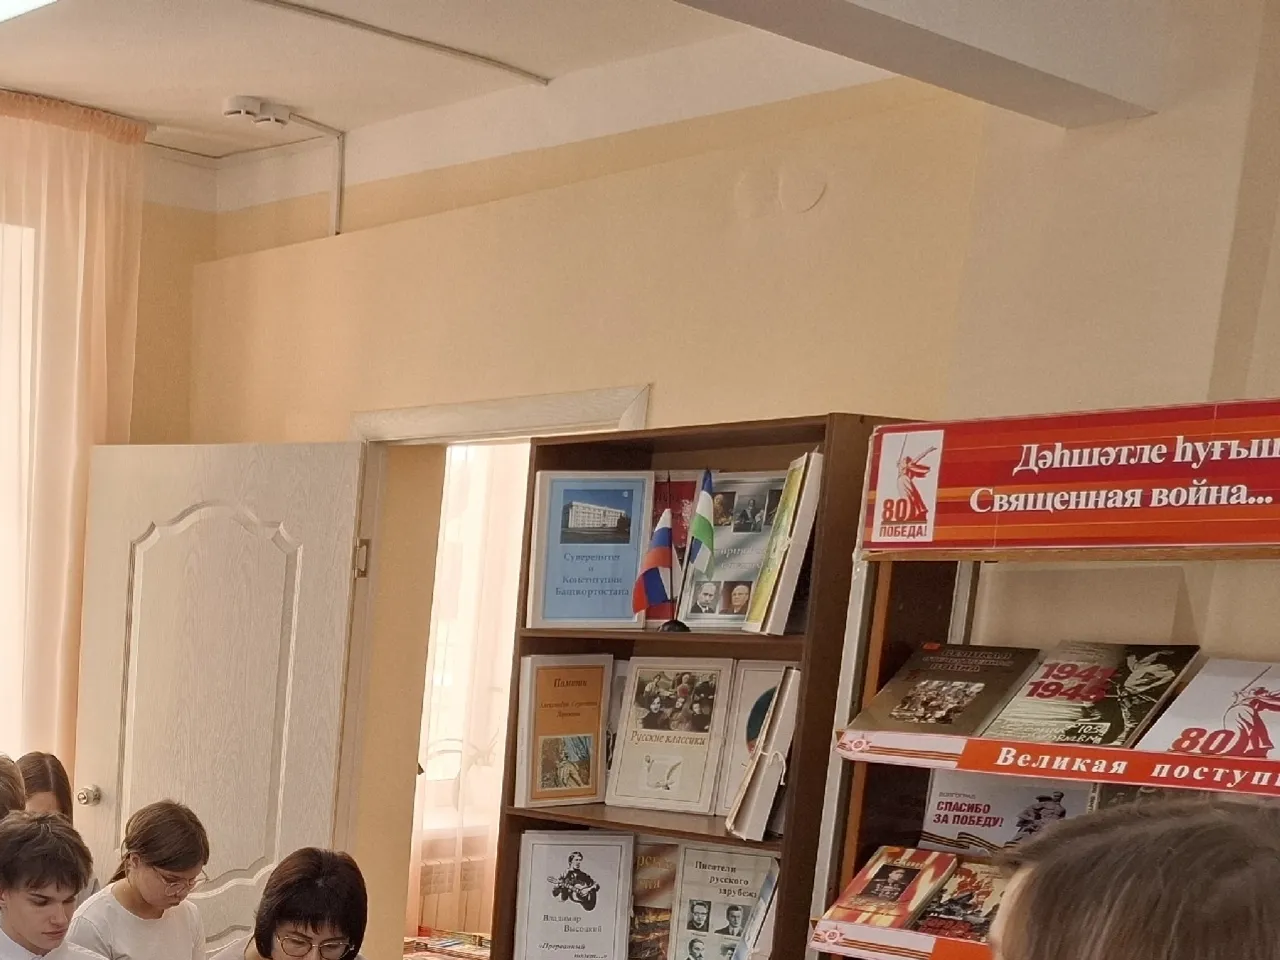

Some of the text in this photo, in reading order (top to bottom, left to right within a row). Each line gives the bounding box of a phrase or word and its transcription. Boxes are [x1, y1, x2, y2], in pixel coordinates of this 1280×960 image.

[1012, 442, 1167, 476] Дәһшәтле
[970, 478, 1273, 514] Священная война...
[881, 498, 911, 522] 80
[879, 525, 928, 538] ПОБЕДА!
[1170, 727, 1235, 753] 80
[995, 746, 1129, 776] Великая
[936, 801, 991, 814] СПАСИБО
[933, 813, 1005, 828] ЗА ПОБЕДУ!
